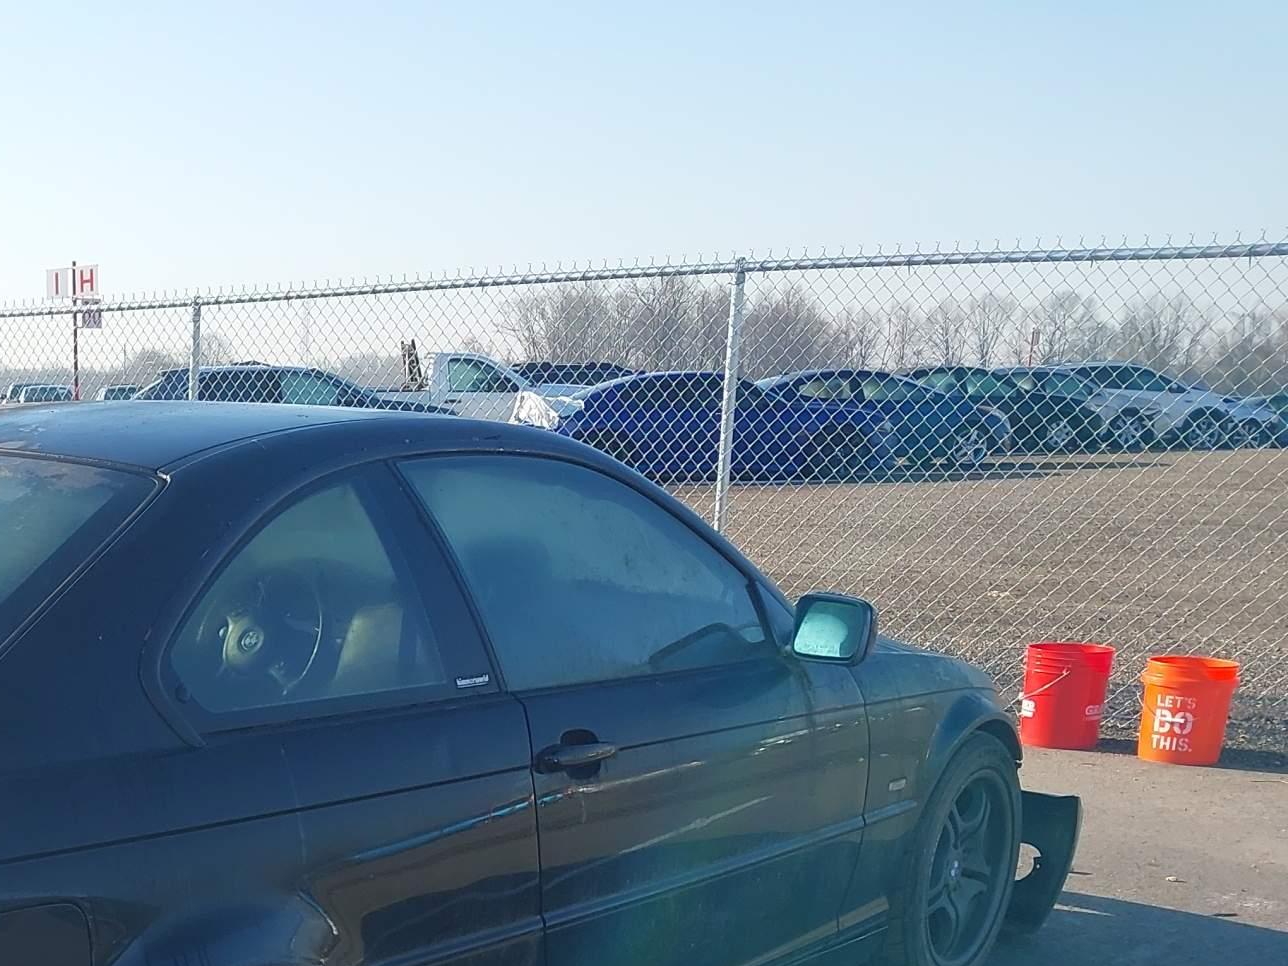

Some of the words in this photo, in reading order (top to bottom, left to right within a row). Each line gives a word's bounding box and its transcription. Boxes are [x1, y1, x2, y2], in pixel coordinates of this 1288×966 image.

[80, 269, 94, 293] H
[1157, 694, 1197, 710] LET'S
[1153, 708, 1193, 735] DO
[1151, 734, 1193, 752] THIS.
